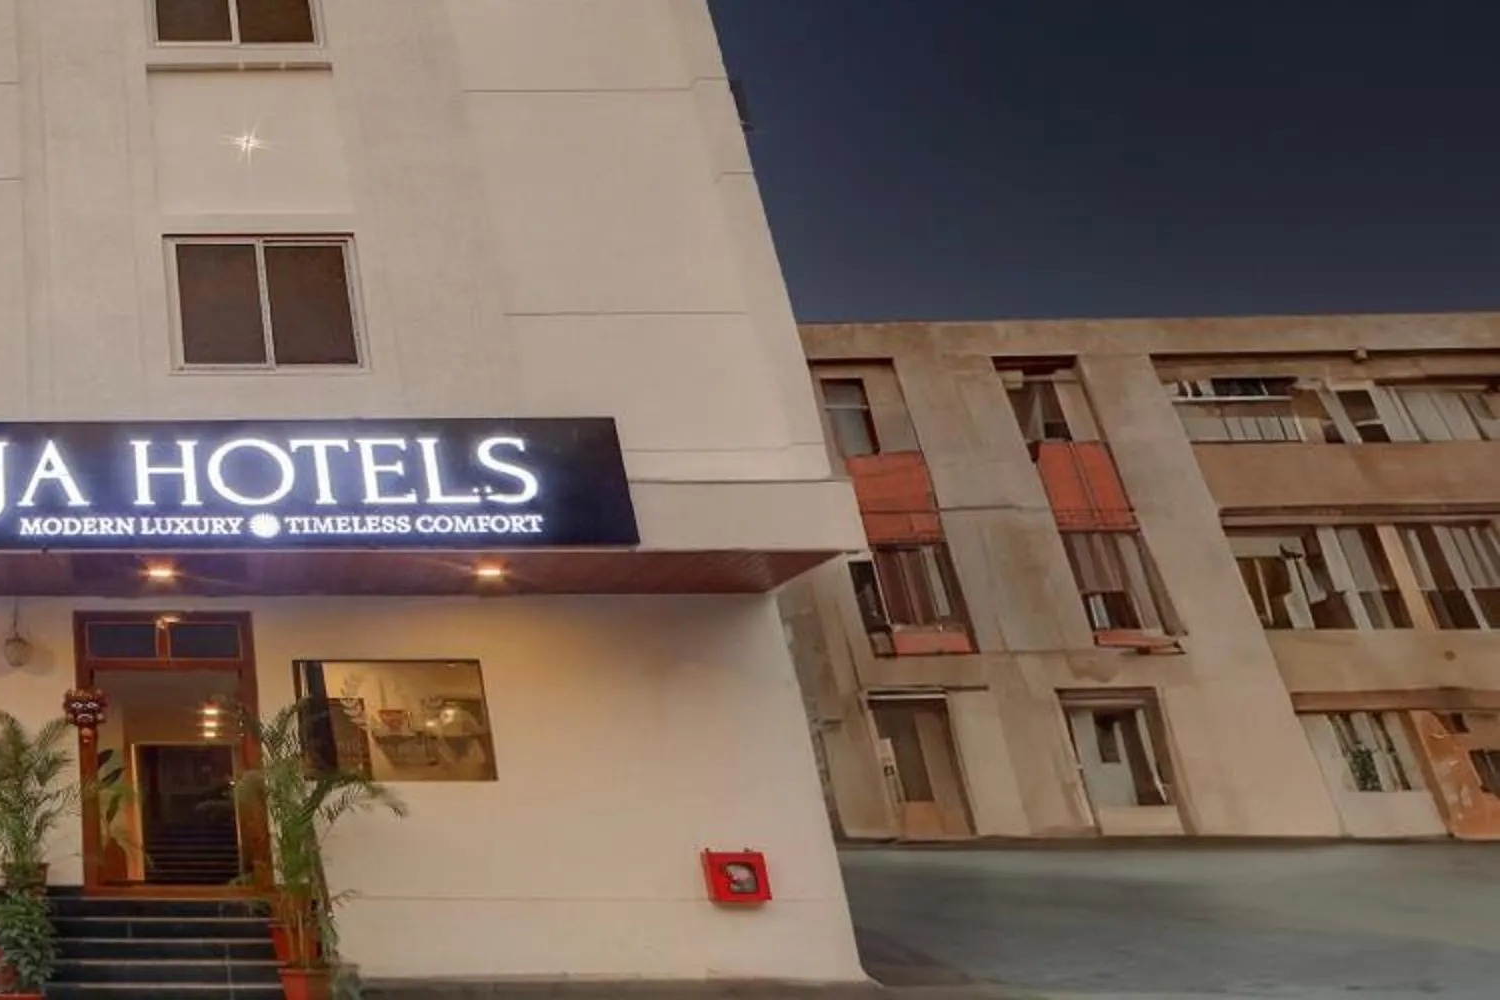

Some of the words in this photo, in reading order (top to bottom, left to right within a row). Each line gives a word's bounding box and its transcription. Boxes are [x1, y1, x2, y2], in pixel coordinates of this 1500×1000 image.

[129, 436, 539, 505] HOTELS
[19, 516, 136, 536] MODERN
[139, 516, 244, 536] LUXURY
[284, 514, 412, 535] TIMELESS
[414, 513, 543, 534] COMFORT
